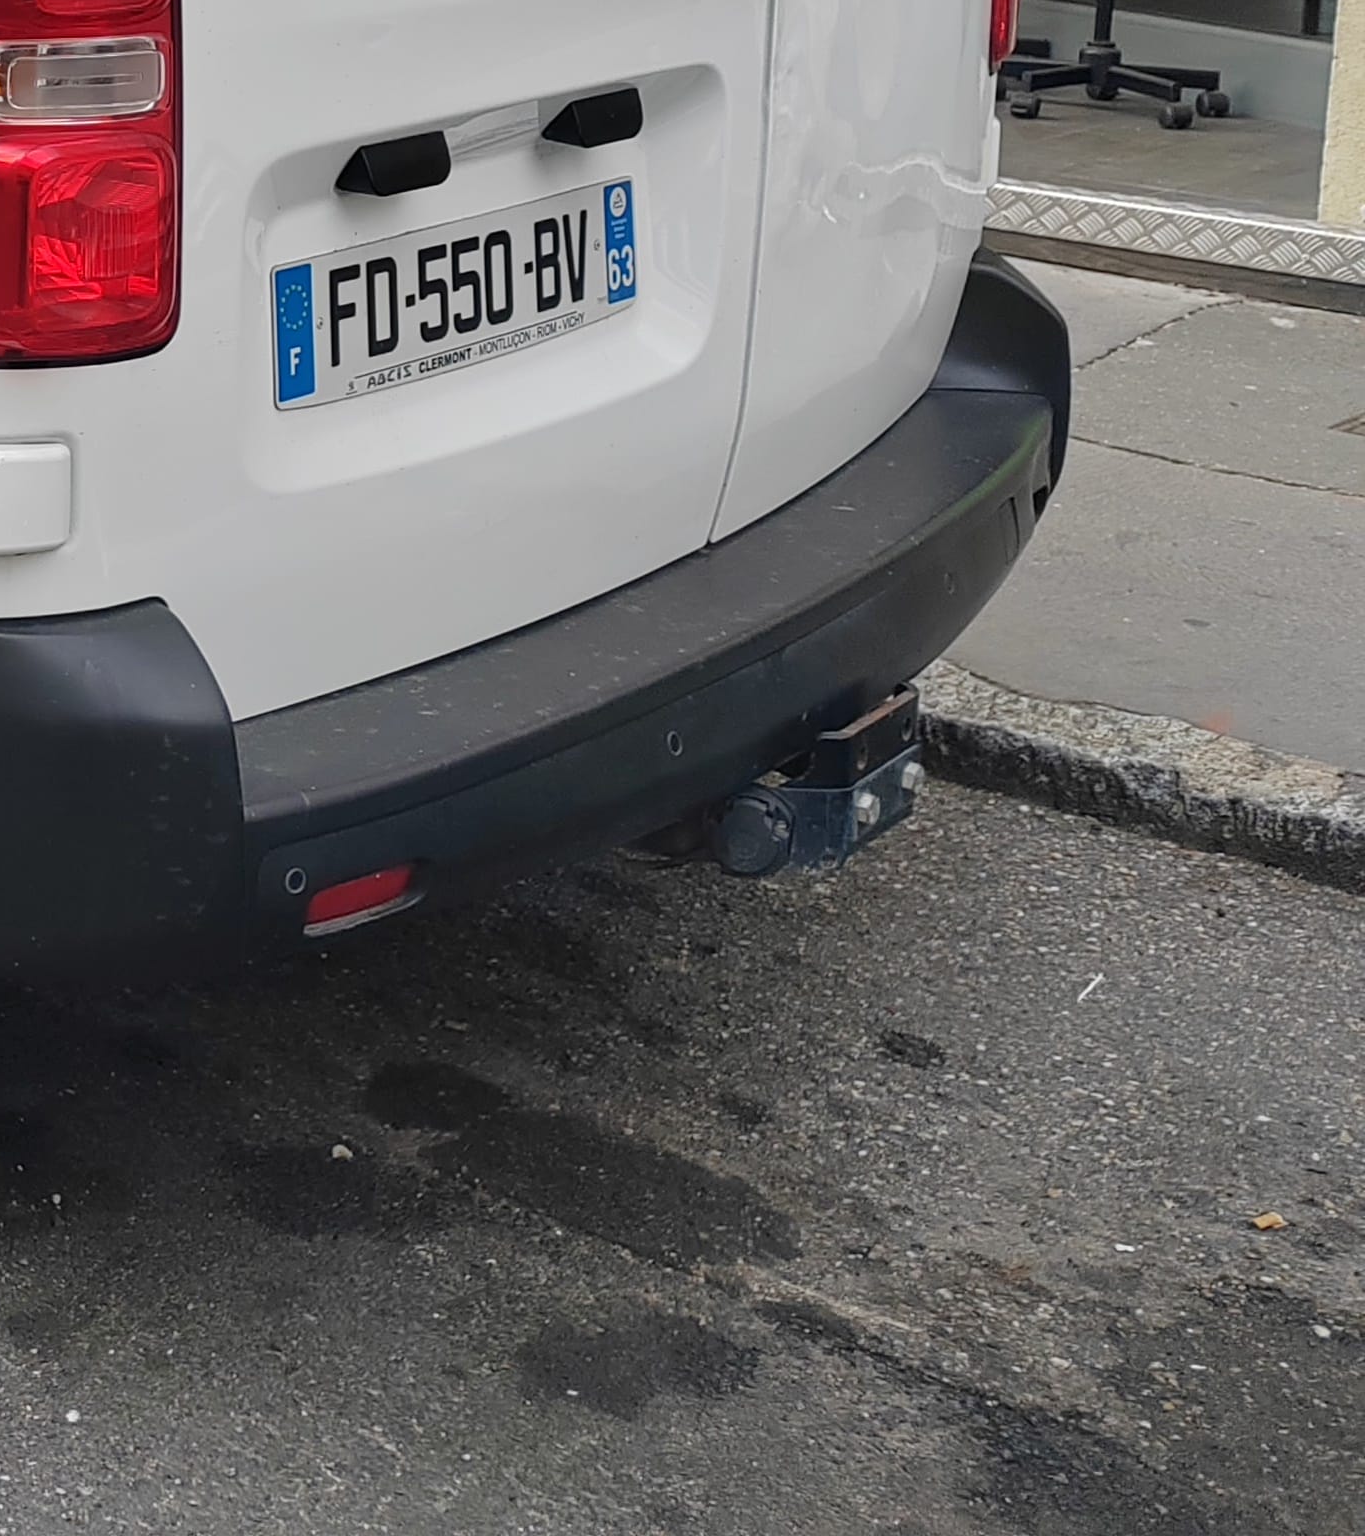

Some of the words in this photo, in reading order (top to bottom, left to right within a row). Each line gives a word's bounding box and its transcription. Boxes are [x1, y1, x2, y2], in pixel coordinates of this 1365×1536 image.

[607, 244, 635, 292] 63
[289, 346, 303, 376] F
[418, 347, 472, 374] CLERMONT
[479, 329, 532, 357] MONTLUÇON
